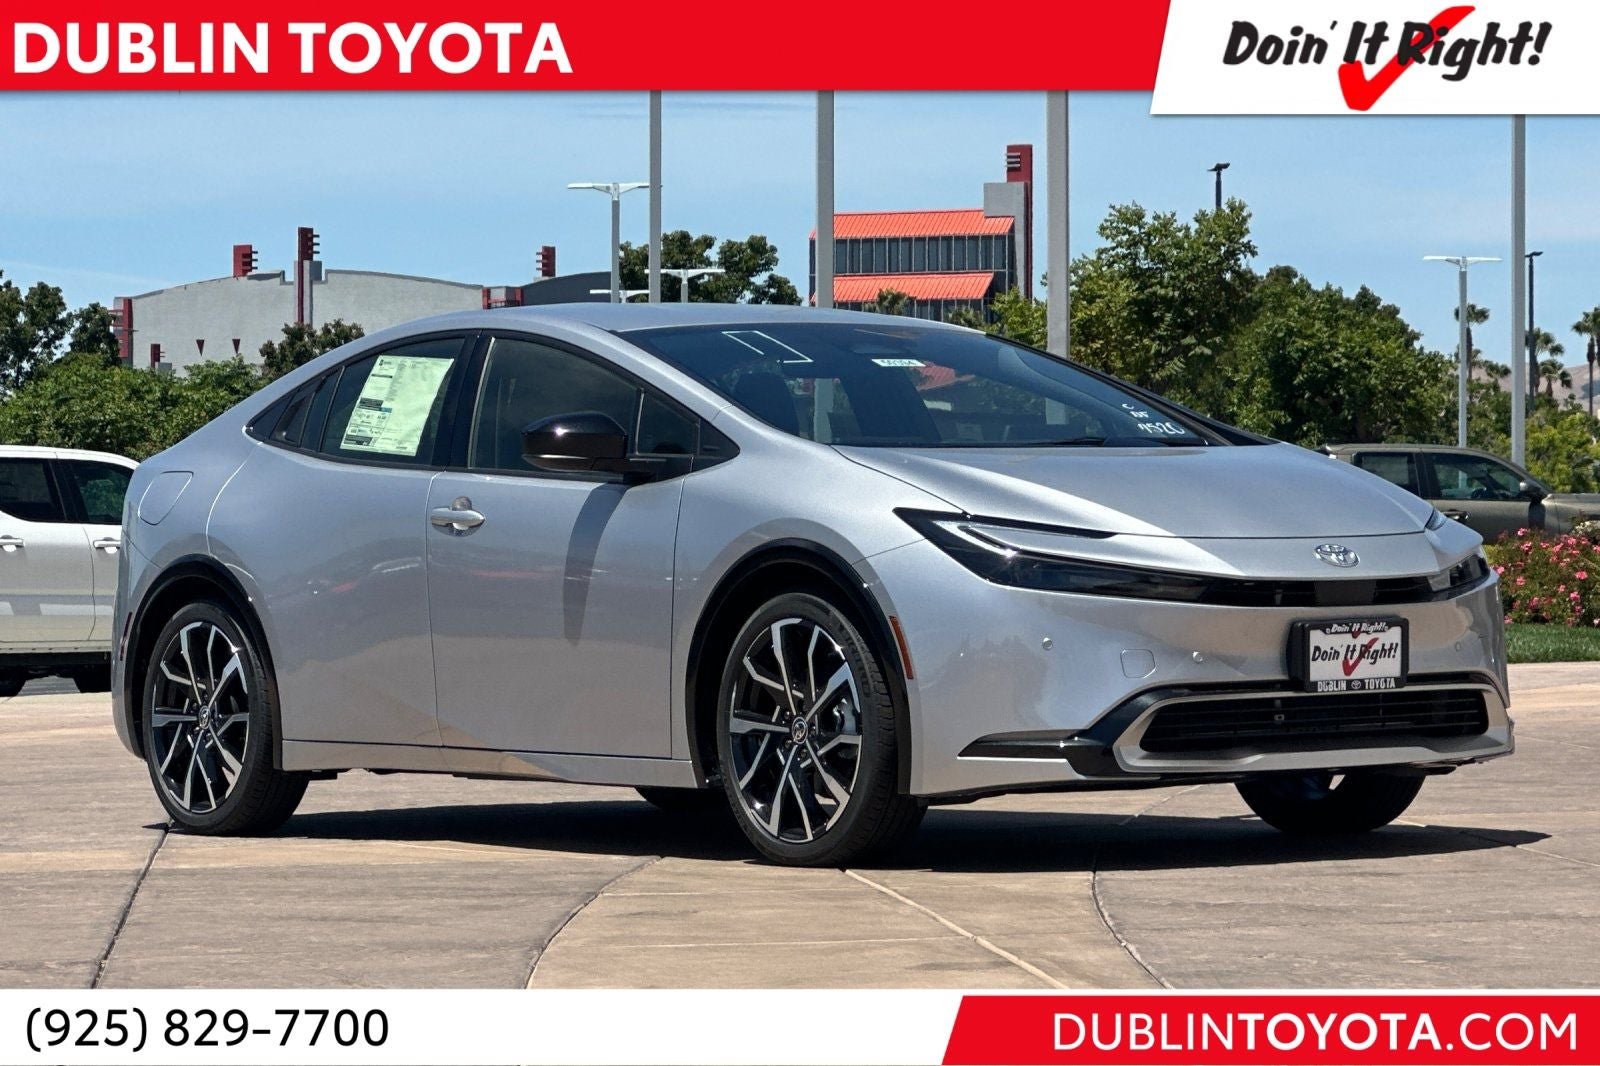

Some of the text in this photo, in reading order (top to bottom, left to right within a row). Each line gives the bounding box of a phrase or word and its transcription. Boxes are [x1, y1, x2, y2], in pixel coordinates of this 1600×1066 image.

[1331, 621, 1386, 634] Doin' It Right!
[1311, 642, 1399, 665] Doin' It Right!
[1317, 677, 1396, 692] DUBLIN TOYOTA
